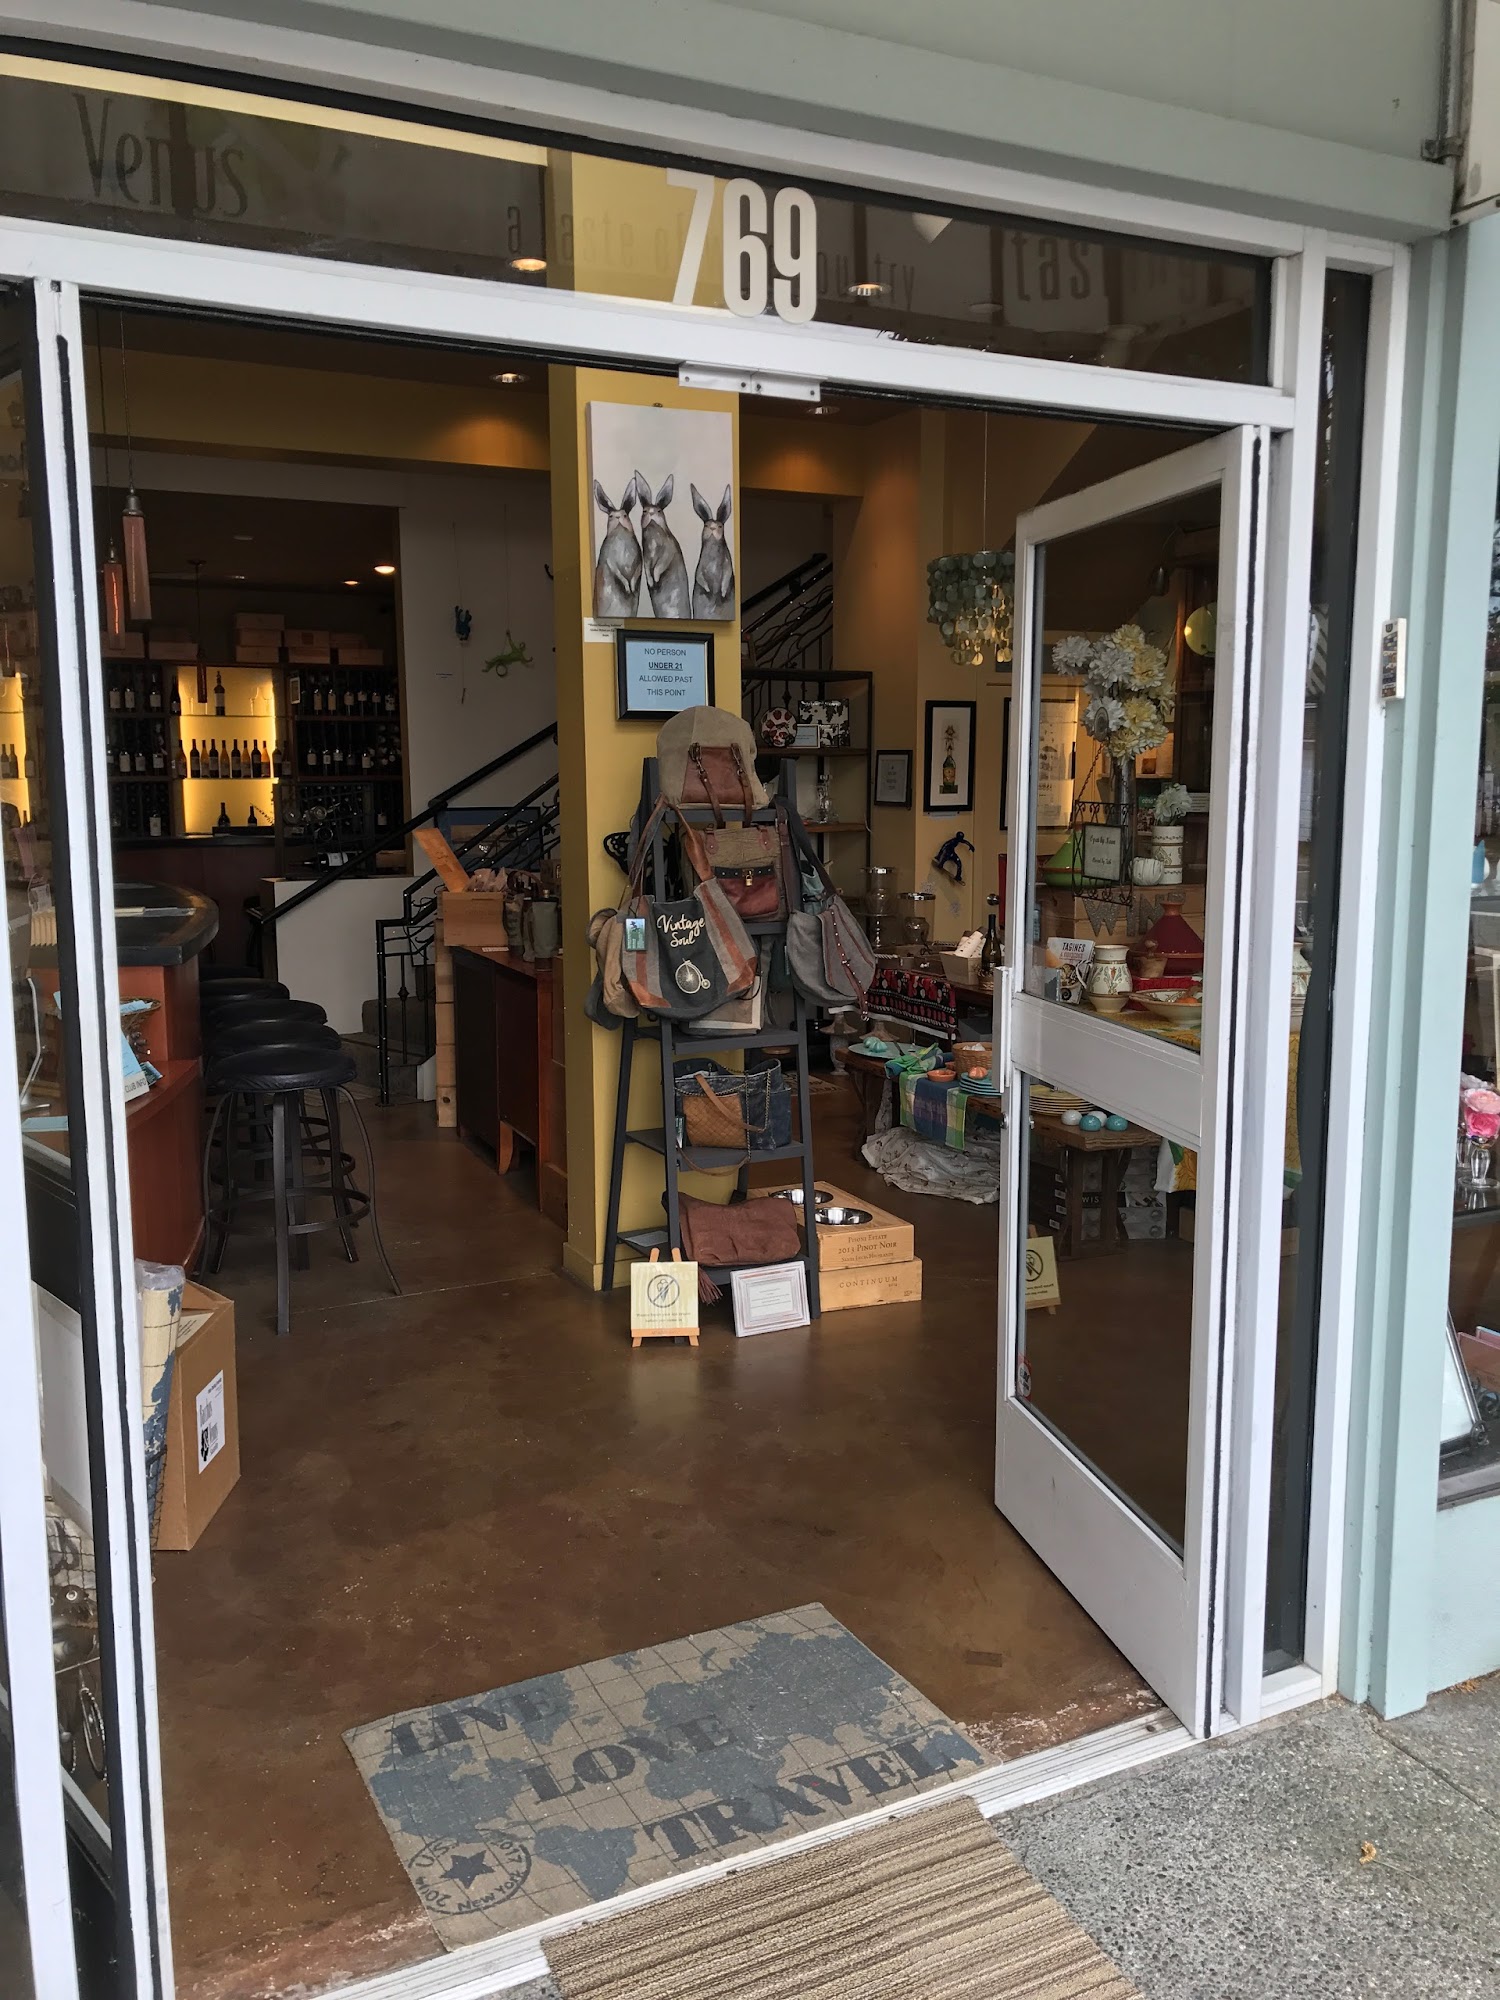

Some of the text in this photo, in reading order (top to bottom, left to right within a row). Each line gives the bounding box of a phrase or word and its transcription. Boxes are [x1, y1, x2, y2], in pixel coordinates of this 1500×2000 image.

[666, 167, 817, 325] 769
[644, 648, 687, 657] NO PERSON
[648, 661, 683, 671] UNDER 21
[639, 674, 693, 684] ALLOWED PAST
[646, 688, 686, 697] THIS POINT
[656, 913, 706, 938] Vintage
[670, 931, 696, 948] Soul
[1062, 942, 1087, 953] TAGINES
[125, 1077, 147, 1093] CLUB INFO
[838, 1241, 897, 1255] 2013 PINOT NOIR
[839, 1275, 898, 1289] CONTINUUM
[384, 1689, 559, 1757] LIVE
[516, 1712, 740, 1806] LOVE
[642, 1739, 959, 1863] TRAVEL
[456, 1869, 526, 1912] NEW YORK
